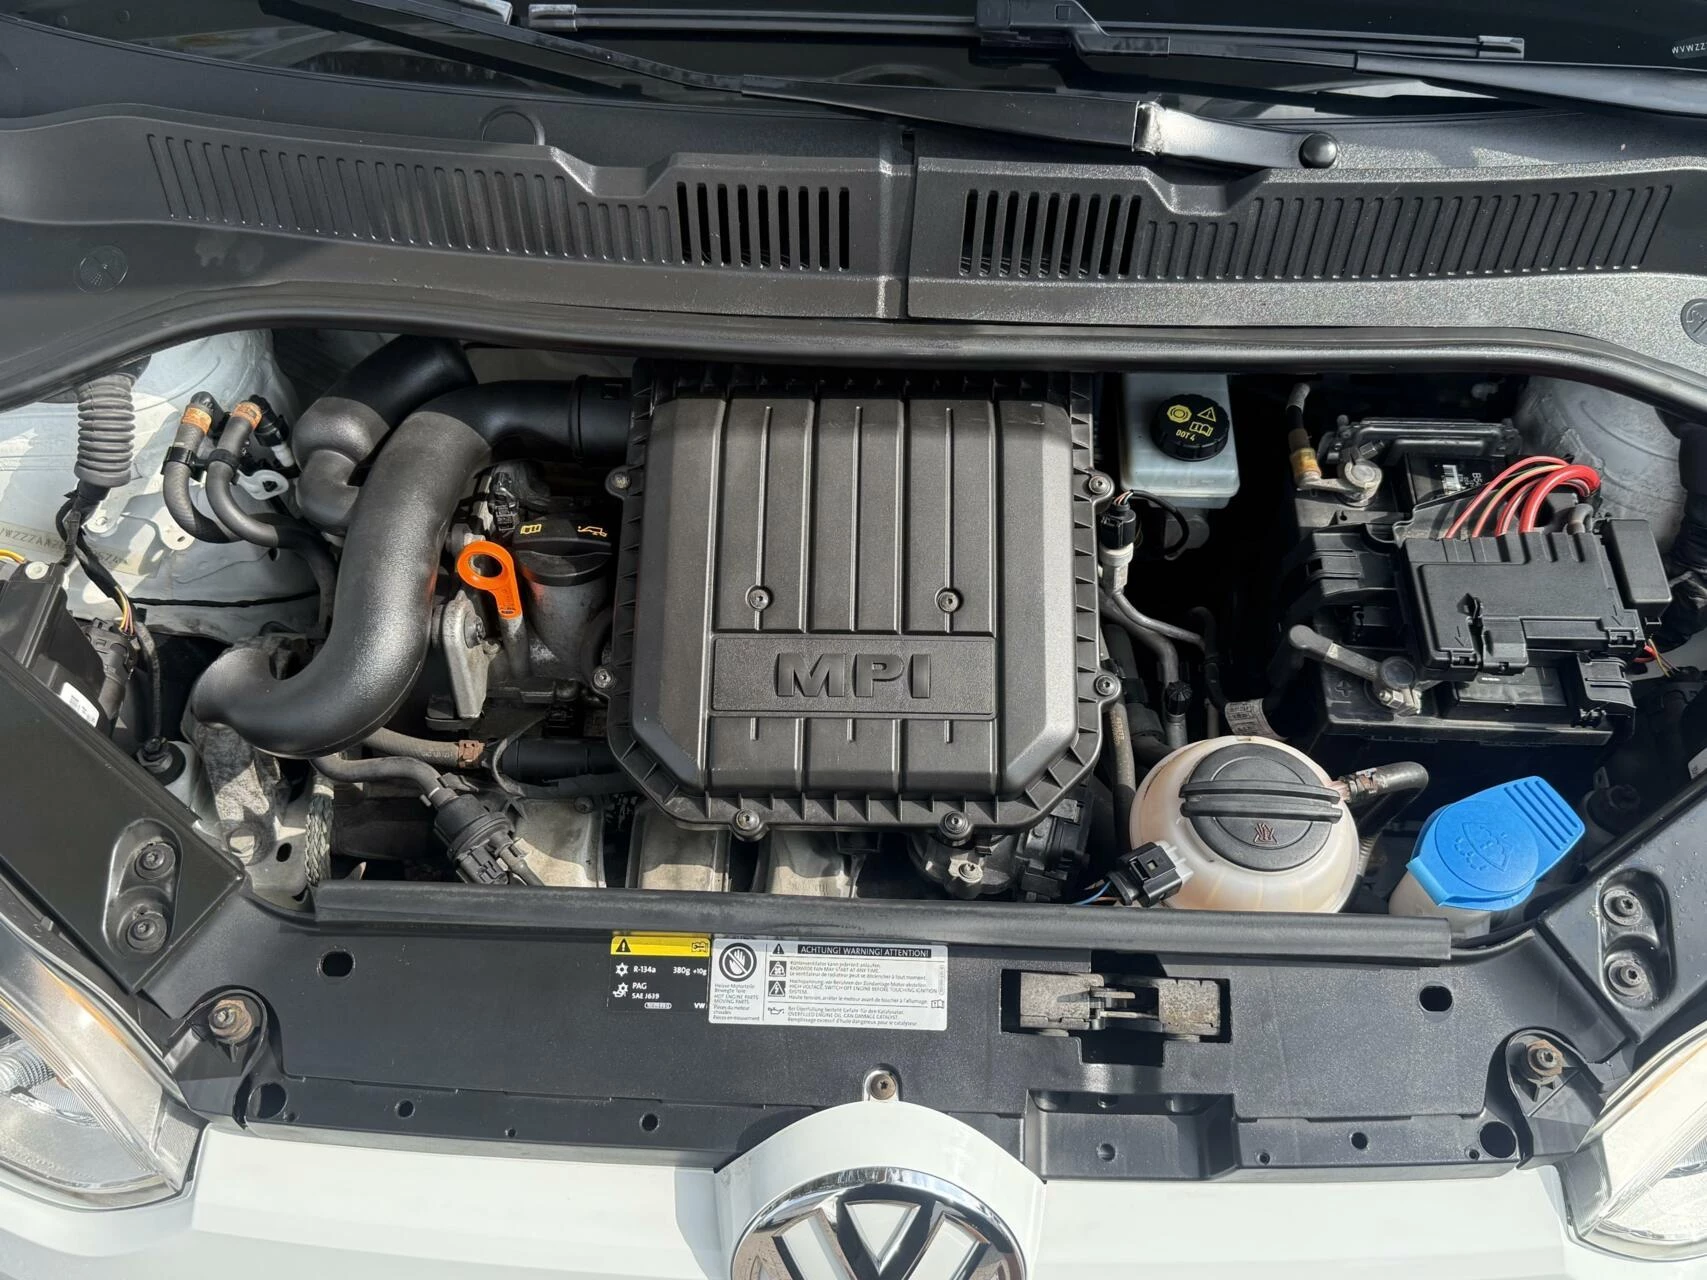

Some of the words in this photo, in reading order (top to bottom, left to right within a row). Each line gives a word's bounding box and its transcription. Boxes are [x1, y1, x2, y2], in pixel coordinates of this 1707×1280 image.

[1671, 42, 1707, 54] WVWZZ
[1176, 429, 1190, 439] DOT
[774, 653, 931, 699] MPI
[800, 946, 840, 954] ACHTUNG!
[843, 948, 883, 956] WARNING!
[633, 965, 657, 974] R-134a
[672, 966, 691, 976] 380g
[632, 982, 648, 990] PAG
